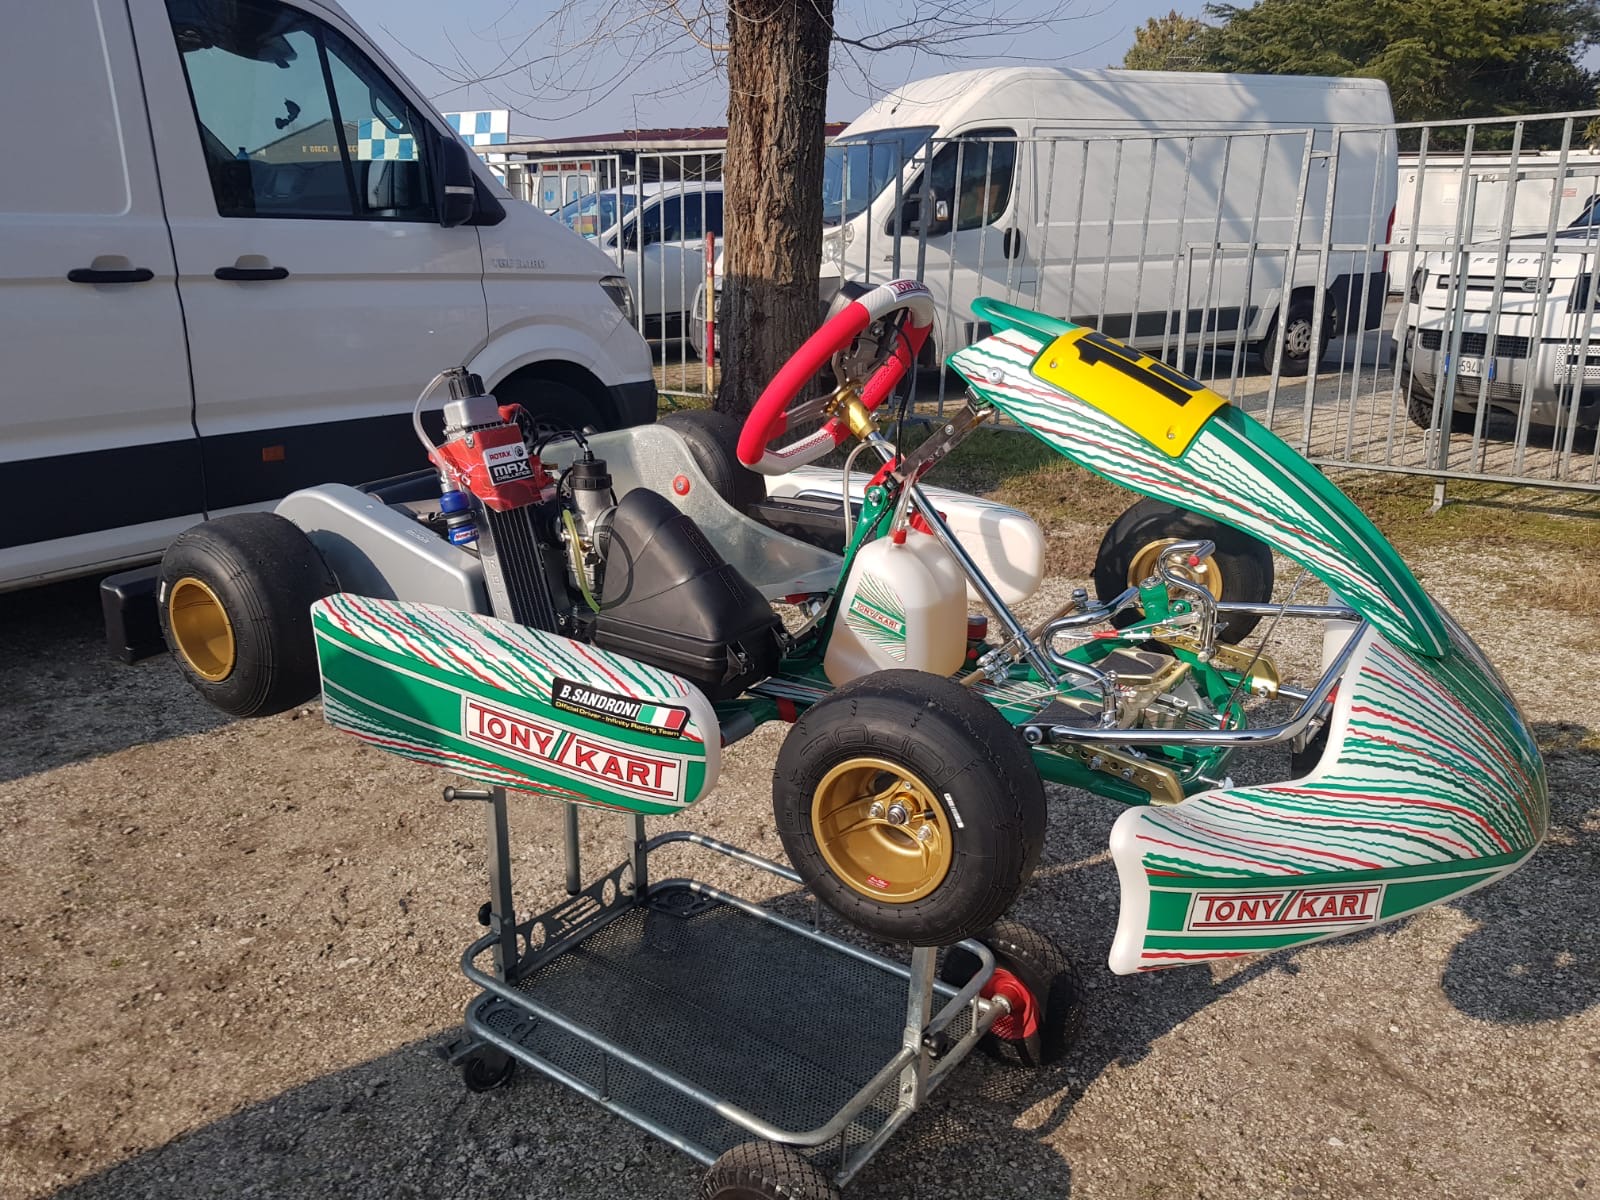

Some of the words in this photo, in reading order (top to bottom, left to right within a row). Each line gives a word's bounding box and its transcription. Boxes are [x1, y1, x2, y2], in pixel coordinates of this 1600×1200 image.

[489, 450, 512, 461] ROTAX
[493, 461, 530, 477] MAX
[496, 470, 531, 481] CHALLENGE
[560, 685, 640, 717] B.SANDRONI
[555, 701, 579, 713] Official
[579, 708, 601, 719] Driver
[605, 716, 630, 728] Infinity
[630, 722, 657, 734] Racing
[658, 728, 680, 737] Team
[470, 703, 554, 754] TONY
[575, 739, 677, 788] KART
[1199, 894, 1284, 921] TONY
[1297, 888, 1379, 918] KART
